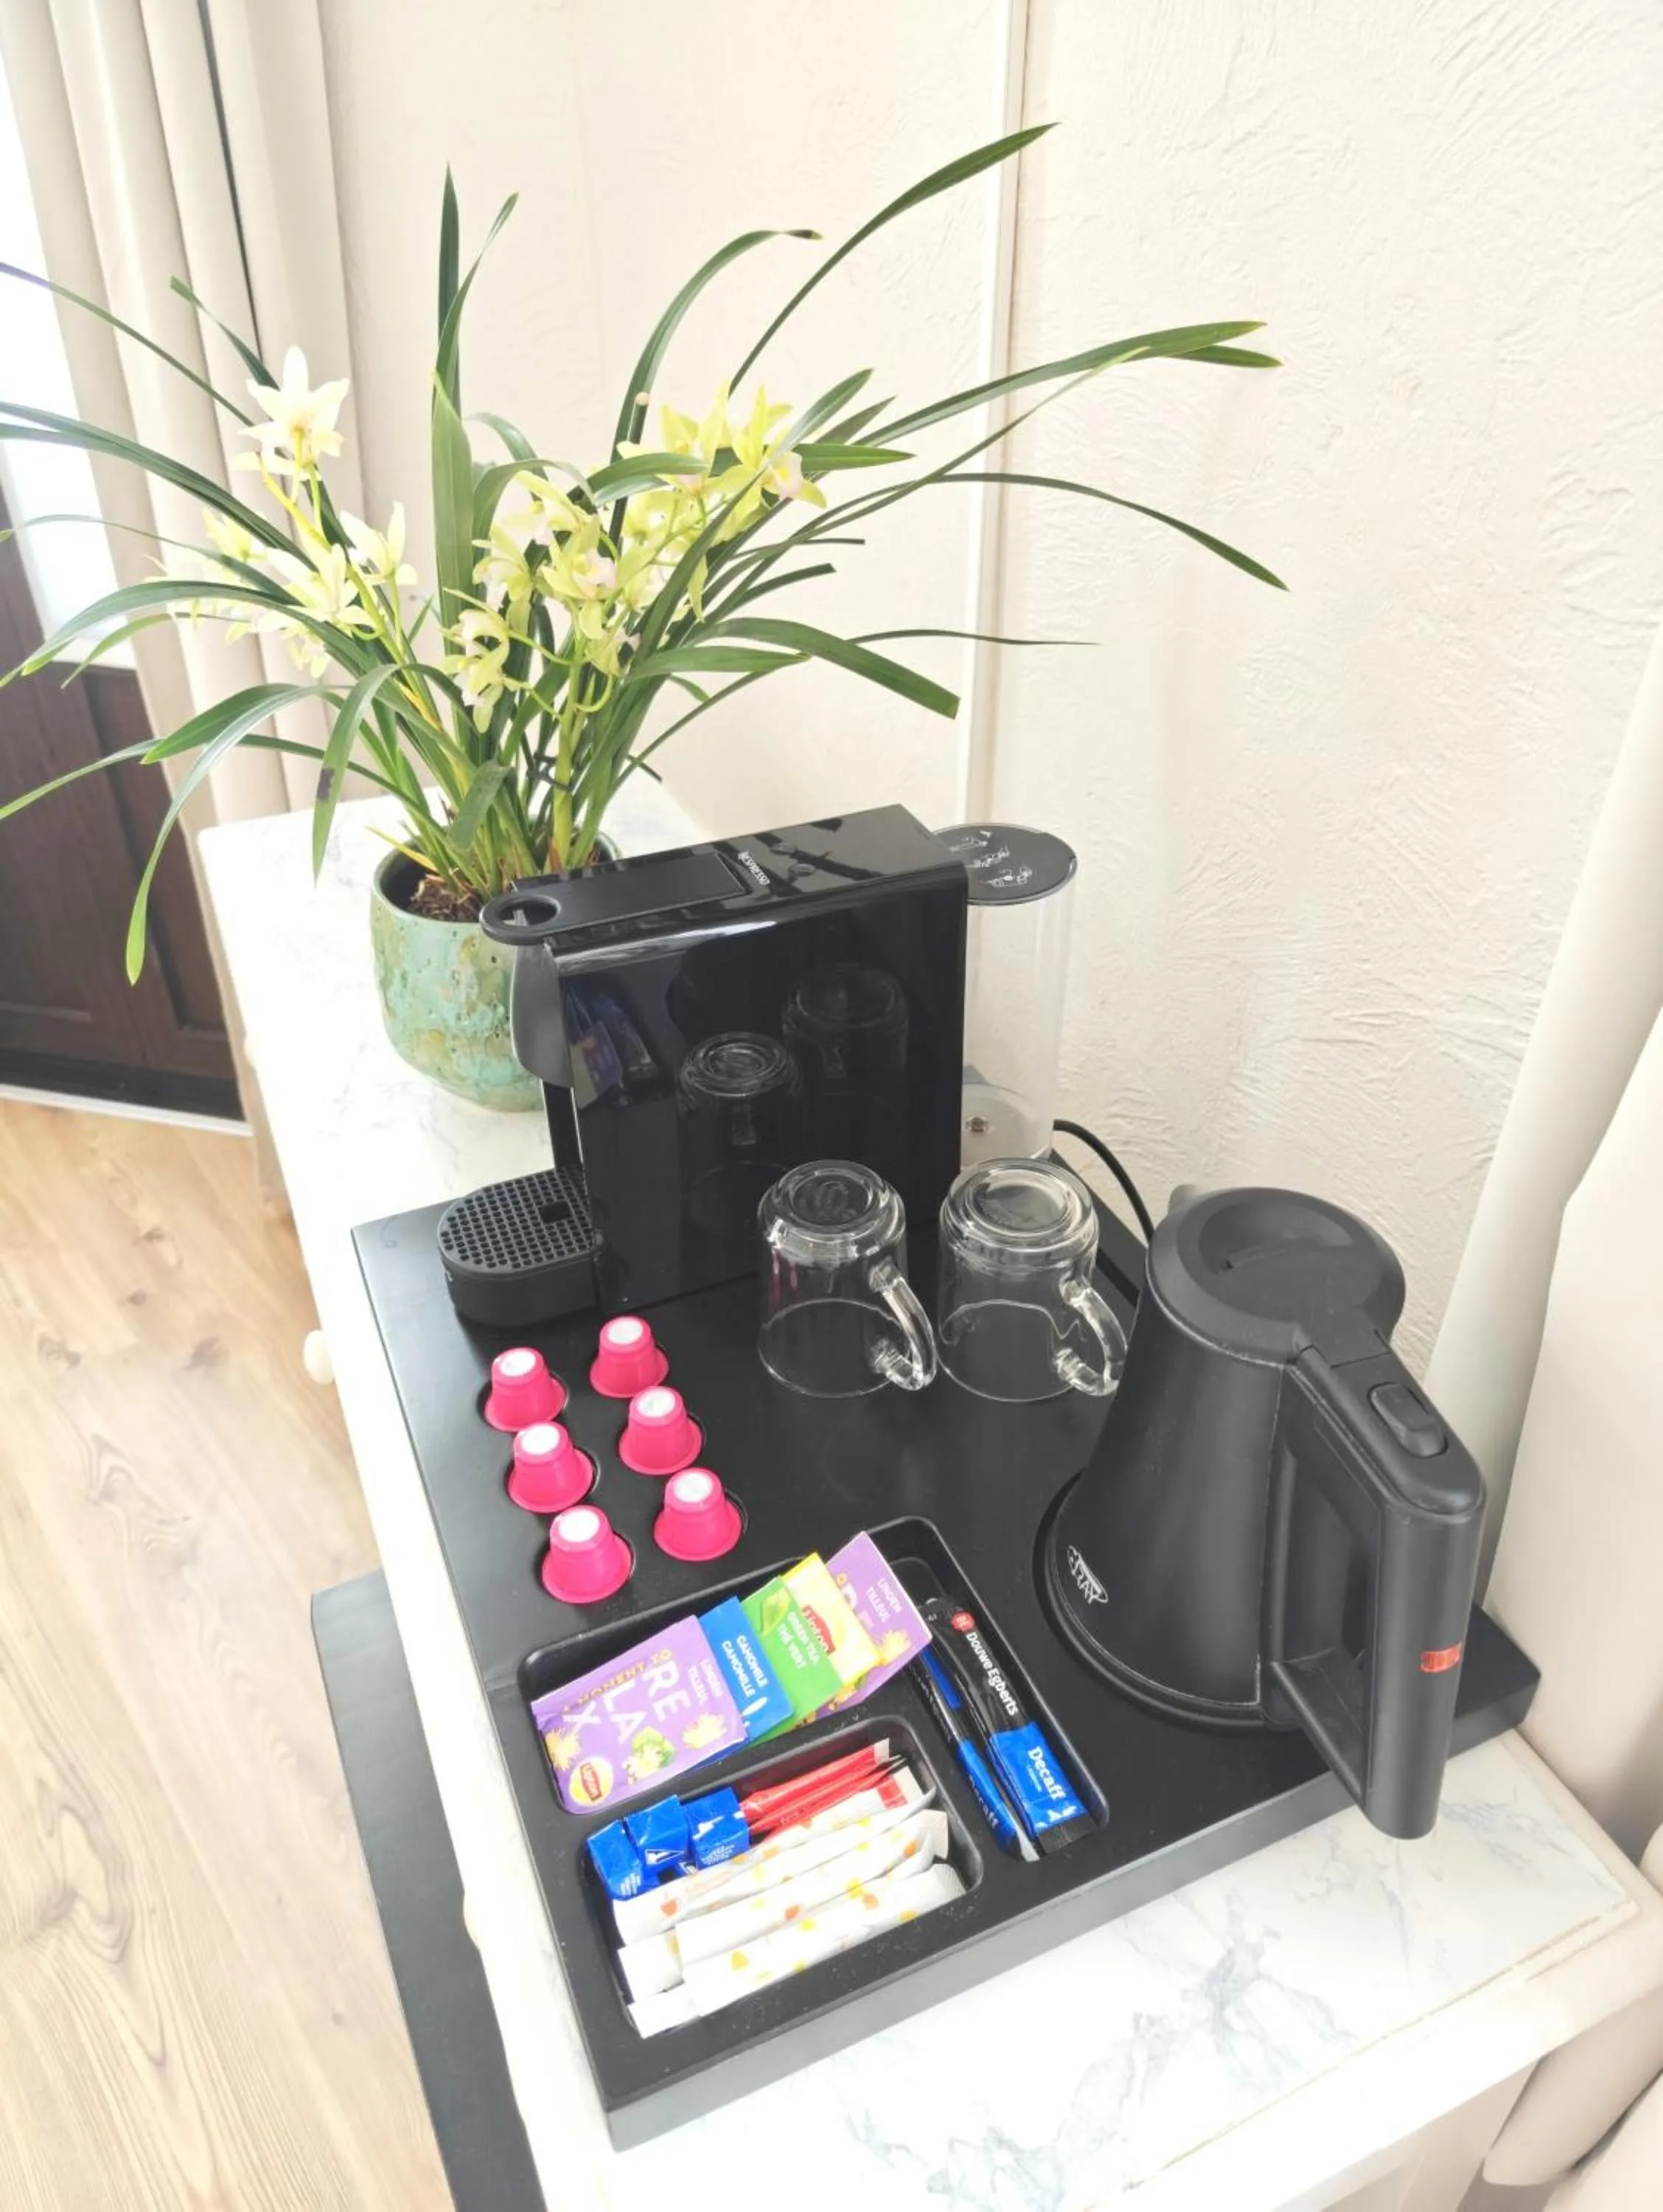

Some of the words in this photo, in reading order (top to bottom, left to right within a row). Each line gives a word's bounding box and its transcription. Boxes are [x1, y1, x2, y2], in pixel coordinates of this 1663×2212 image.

[722, 1640, 756, 1698] CAMOMILLE
[736, 1635, 769, 1688] CAMOMILE
[966, 1632, 993, 1670] Douwe
[987, 1668, 1018, 1716] Egberts
[562, 1700, 602, 1734] X
[602, 1678, 648, 1745] LA
[642, 1660, 692, 1722] RE
[1027, 1745, 1067, 1801] Decaff
